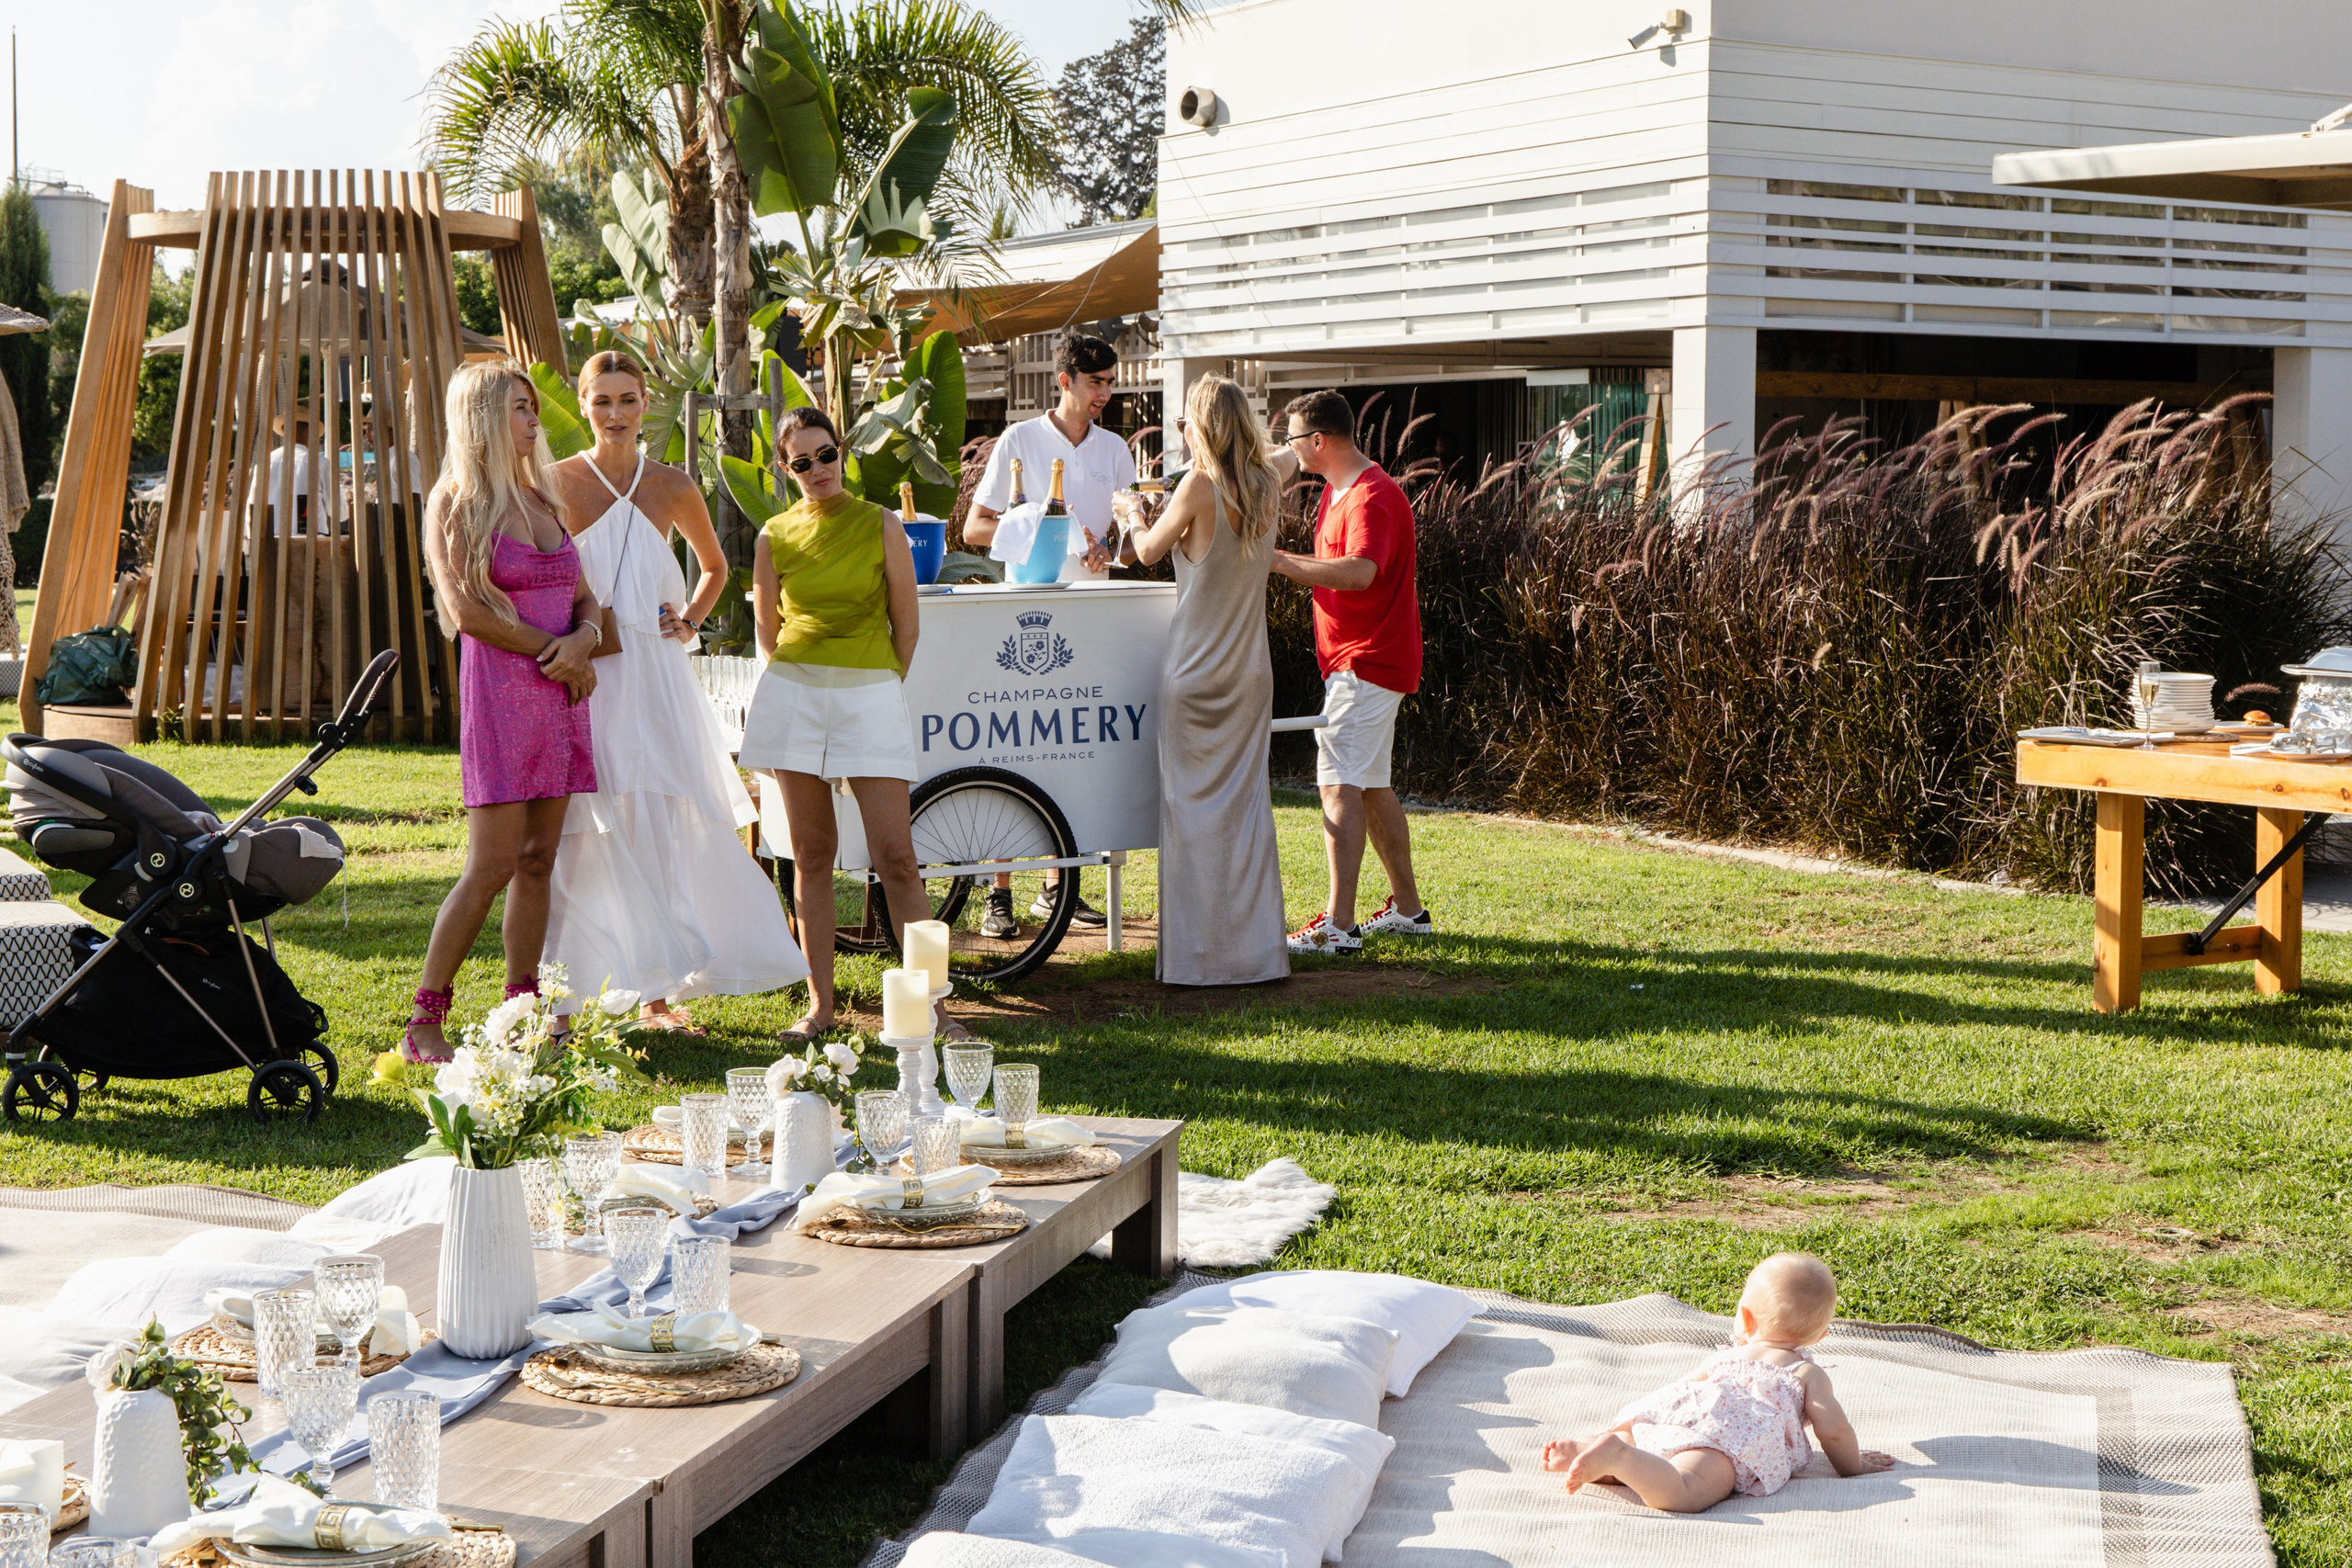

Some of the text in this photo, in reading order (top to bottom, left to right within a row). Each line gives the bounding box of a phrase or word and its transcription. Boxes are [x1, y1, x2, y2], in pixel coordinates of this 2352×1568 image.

[911, 539, 928, 547] ERY
[967, 685, 1103, 705] CHAMPAGNE
[922, 704, 1147, 751] POMMERY
[992, 750, 1095, 763] REIMS-FRANCE
